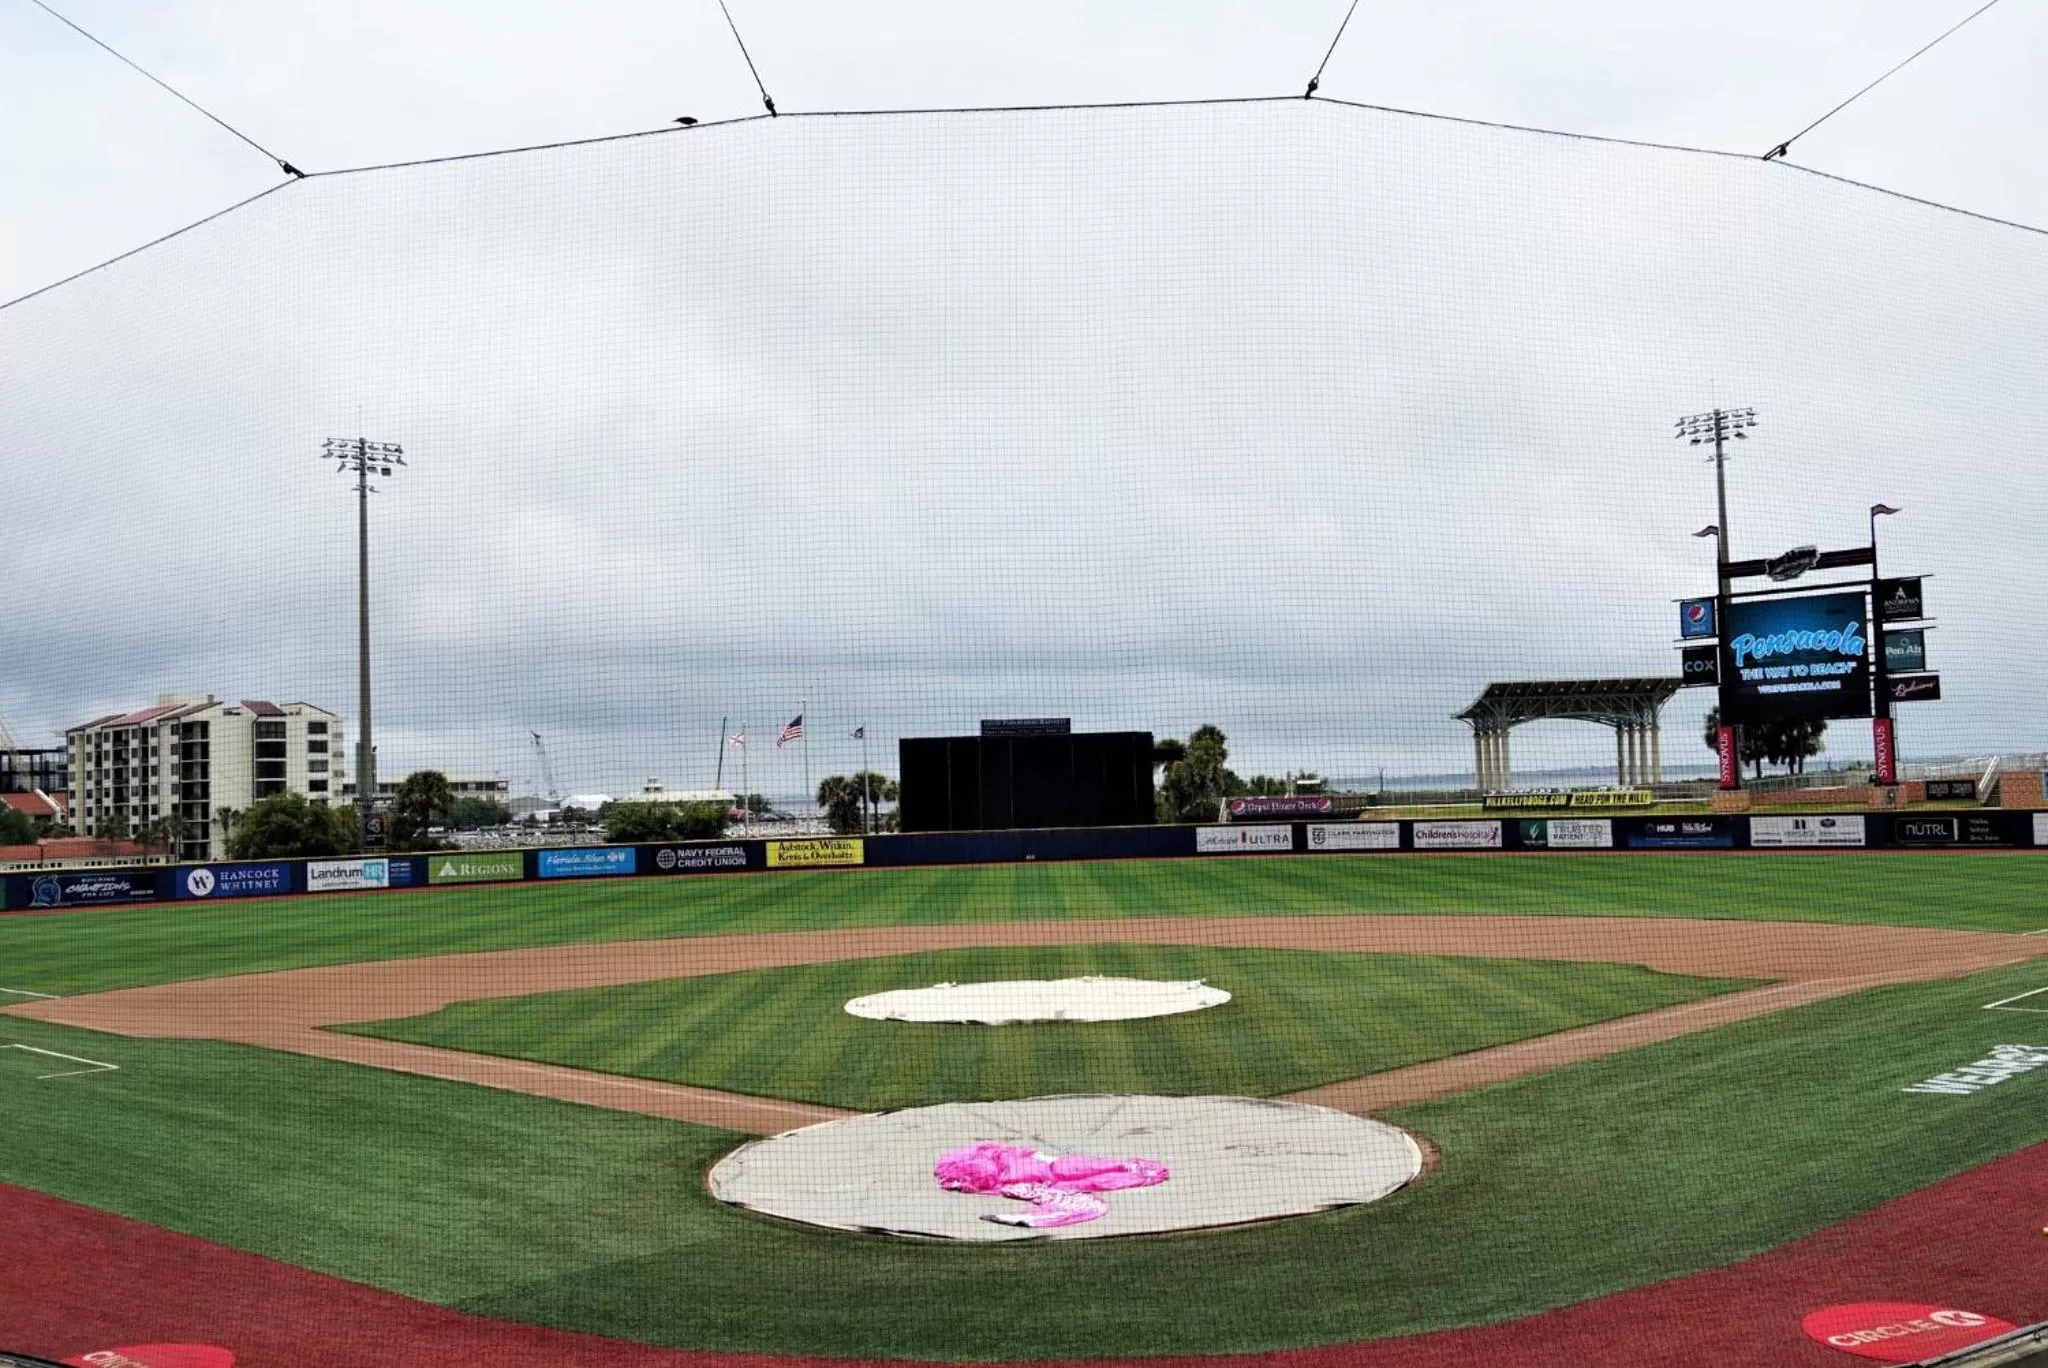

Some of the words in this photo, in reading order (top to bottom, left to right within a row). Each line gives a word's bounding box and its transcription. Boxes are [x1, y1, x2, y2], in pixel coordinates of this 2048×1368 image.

[1731, 621, 1866, 667] Pensacola
[1684, 660, 1714, 672] COX
[1740, 667, 1764, 681] THE
[1764, 665, 1790, 679] WAY
[1791, 664, 1809, 677] TO
[1719, 732, 1730, 782] SYNOVUS
[1876, 725, 1888, 777] SYNOVUS
[1613, 791, 1628, 803] THE
[1416, 830, 1457, 839] Children's
[1656, 824, 1675, 833] HUB
[1250, 834, 1289, 844] ULTRA
[677, 848, 703, 857] NAVY
[705, 846, 746, 857] FEDERAL
[678, 858, 713, 868] CREDIT
[715, 857, 746, 866] UNION
[220, 869, 279, 880] HANCOCK
[311, 867, 363, 880] Landrum
[461, 863, 514, 876] REGIONS
[221, 879, 279, 890] WHITNEY
[1827, 1319, 1941, 1347] CIRCLE
